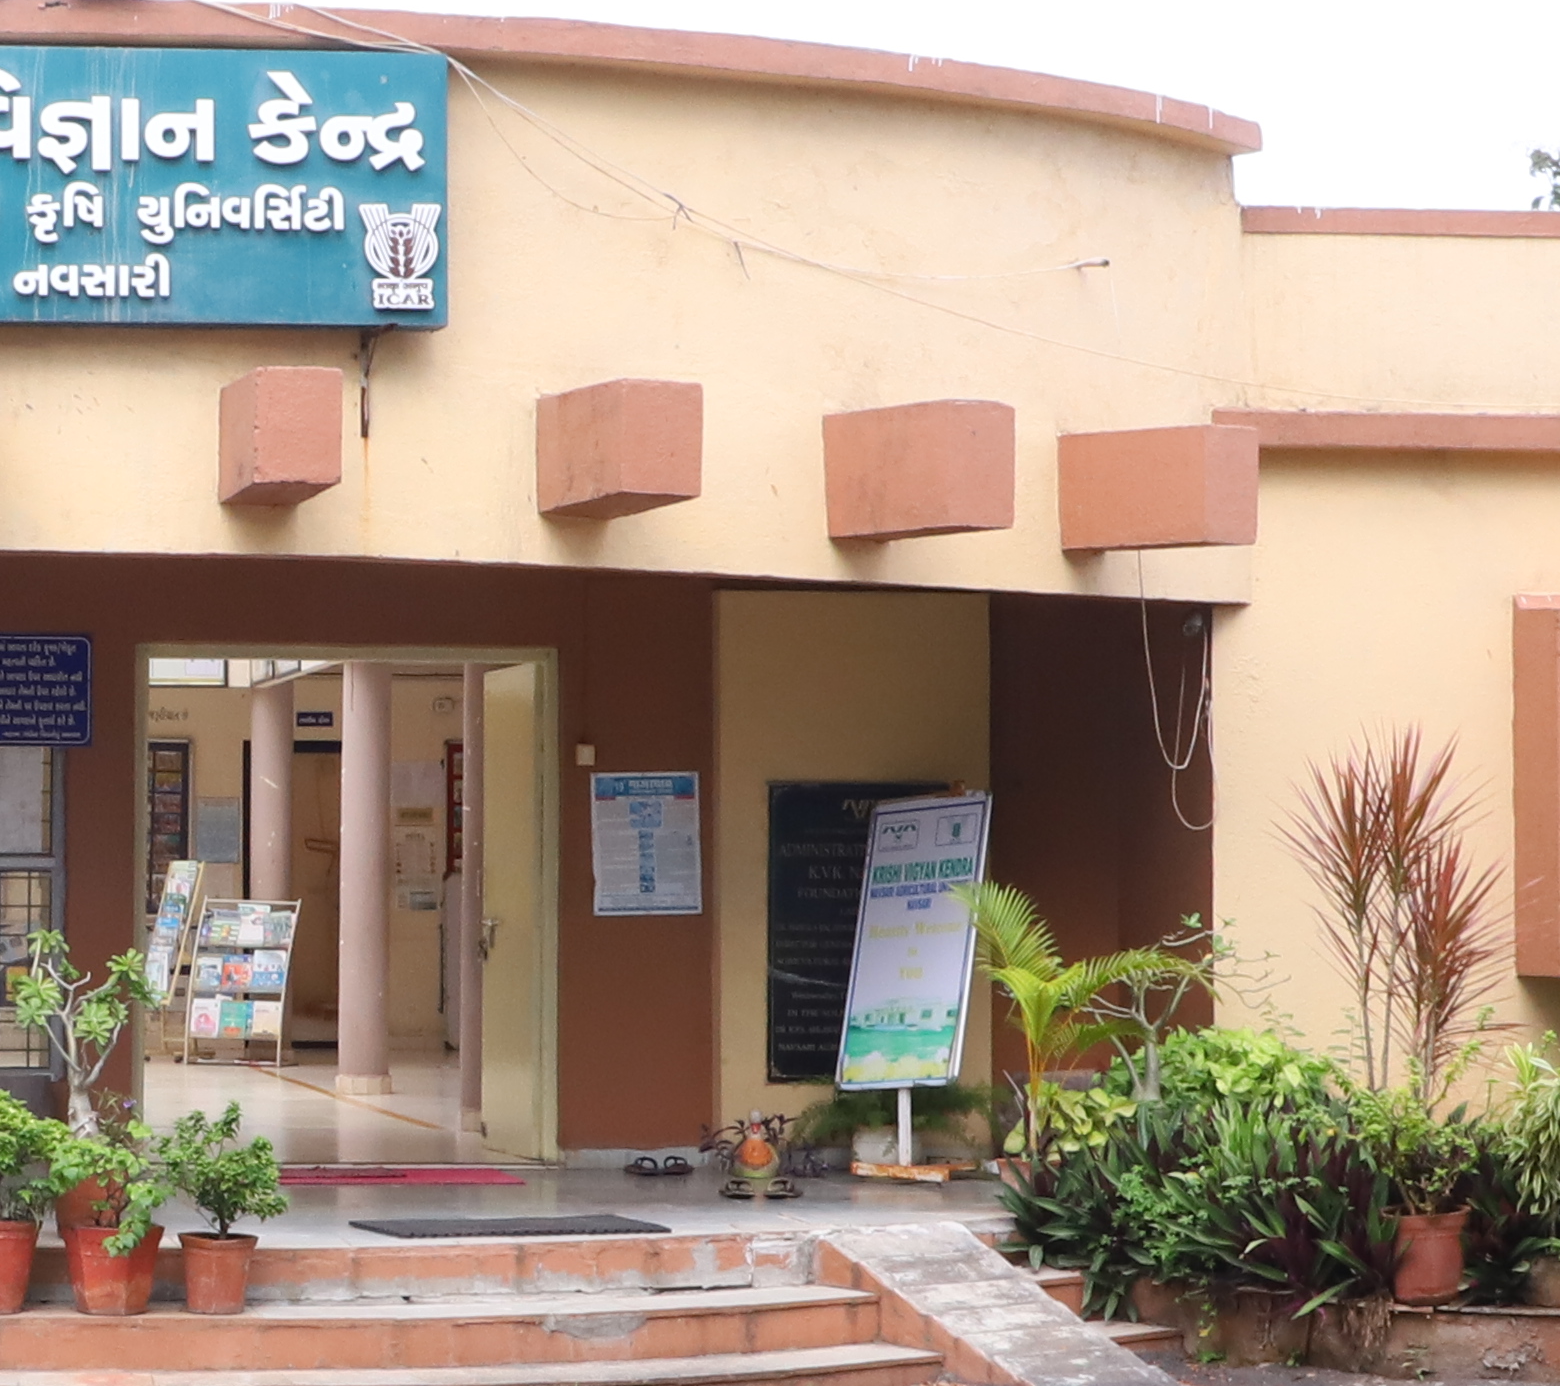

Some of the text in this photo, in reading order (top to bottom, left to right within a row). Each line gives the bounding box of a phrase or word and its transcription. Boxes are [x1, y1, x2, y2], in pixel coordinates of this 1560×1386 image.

[248, 70, 425, 171] કેન્દ્ર
[25, 180, 104, 243] કૃષિ
[136, 181, 344, 245] યુનિવર્સિટી
[12, 252, 171, 298] નવસારી
[378, 293, 430, 305] ICAR
[781, 843, 867, 856] ADMINISTRATI
[872, 856, 974, 885] KRISHI VIGYAN KENDRA
[797, 887, 861, 899] FOUNDATI
